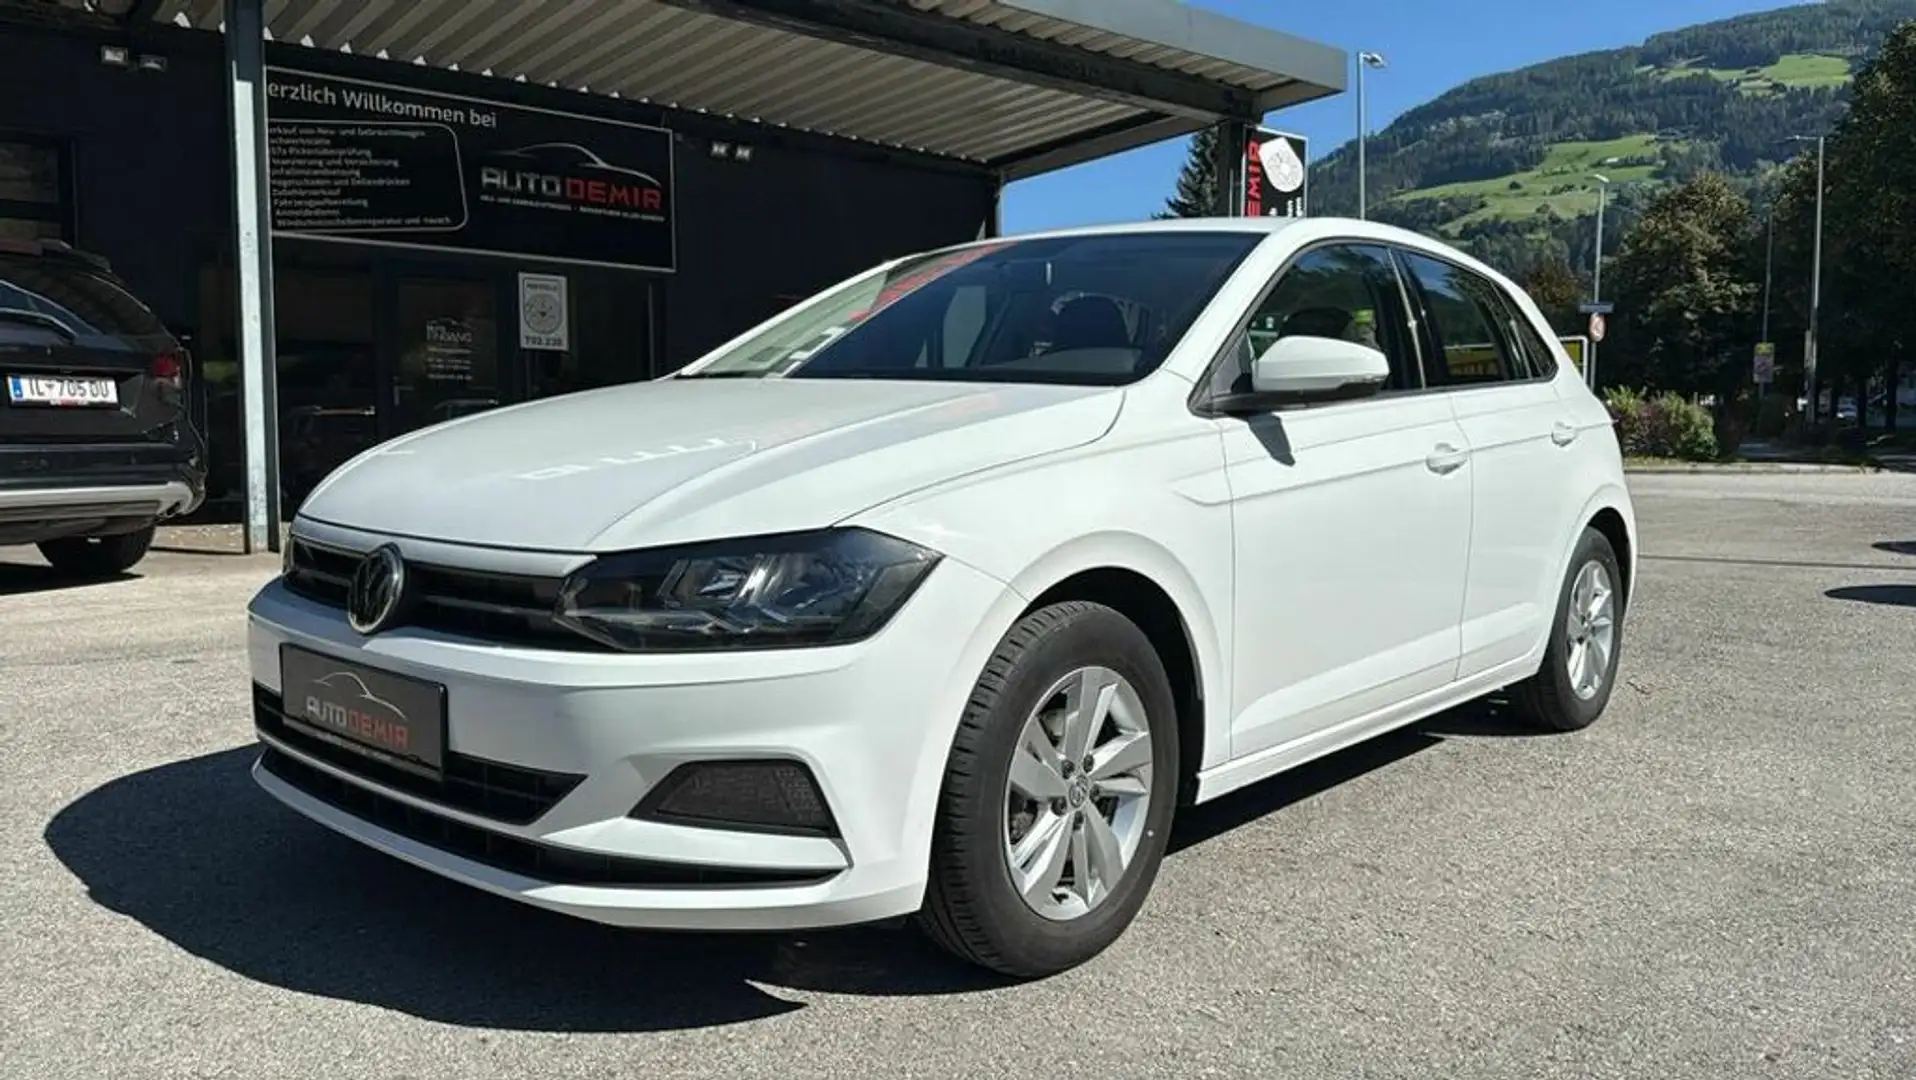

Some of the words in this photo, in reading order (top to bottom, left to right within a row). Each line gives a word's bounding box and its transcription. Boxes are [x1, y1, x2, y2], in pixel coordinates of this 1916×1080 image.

[268, 82, 337, 106] erzlich
[342, 89, 465, 124] Willkommen
[469, 107, 497, 129] bei
[1247, 140, 1261, 217] EMIR
